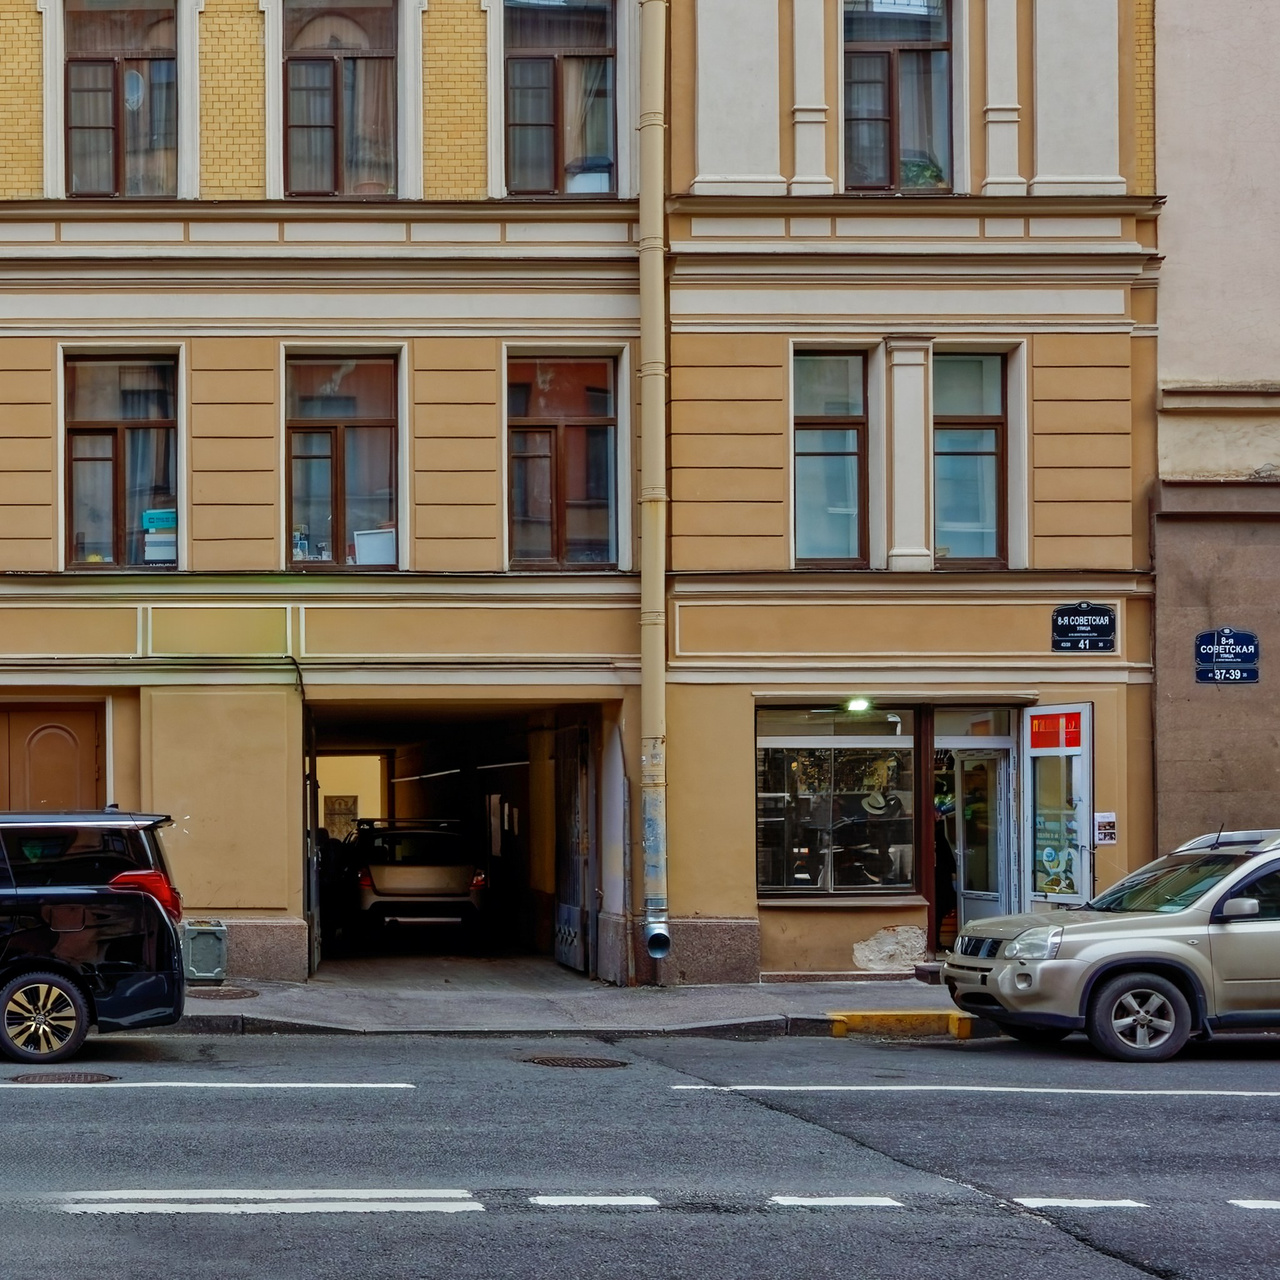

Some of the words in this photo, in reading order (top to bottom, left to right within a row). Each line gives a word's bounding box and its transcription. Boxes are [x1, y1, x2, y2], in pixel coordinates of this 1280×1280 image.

[1057, 616, 1069, 625] 8-Я
[1070, 616, 1109, 625] СОВЕТСКАЯ
[1078, 639, 1089, 649] 41
[1200, 645, 1255, 653] СОВЕТСКАЯ
[1214, 669, 1241, 680] 37-39
